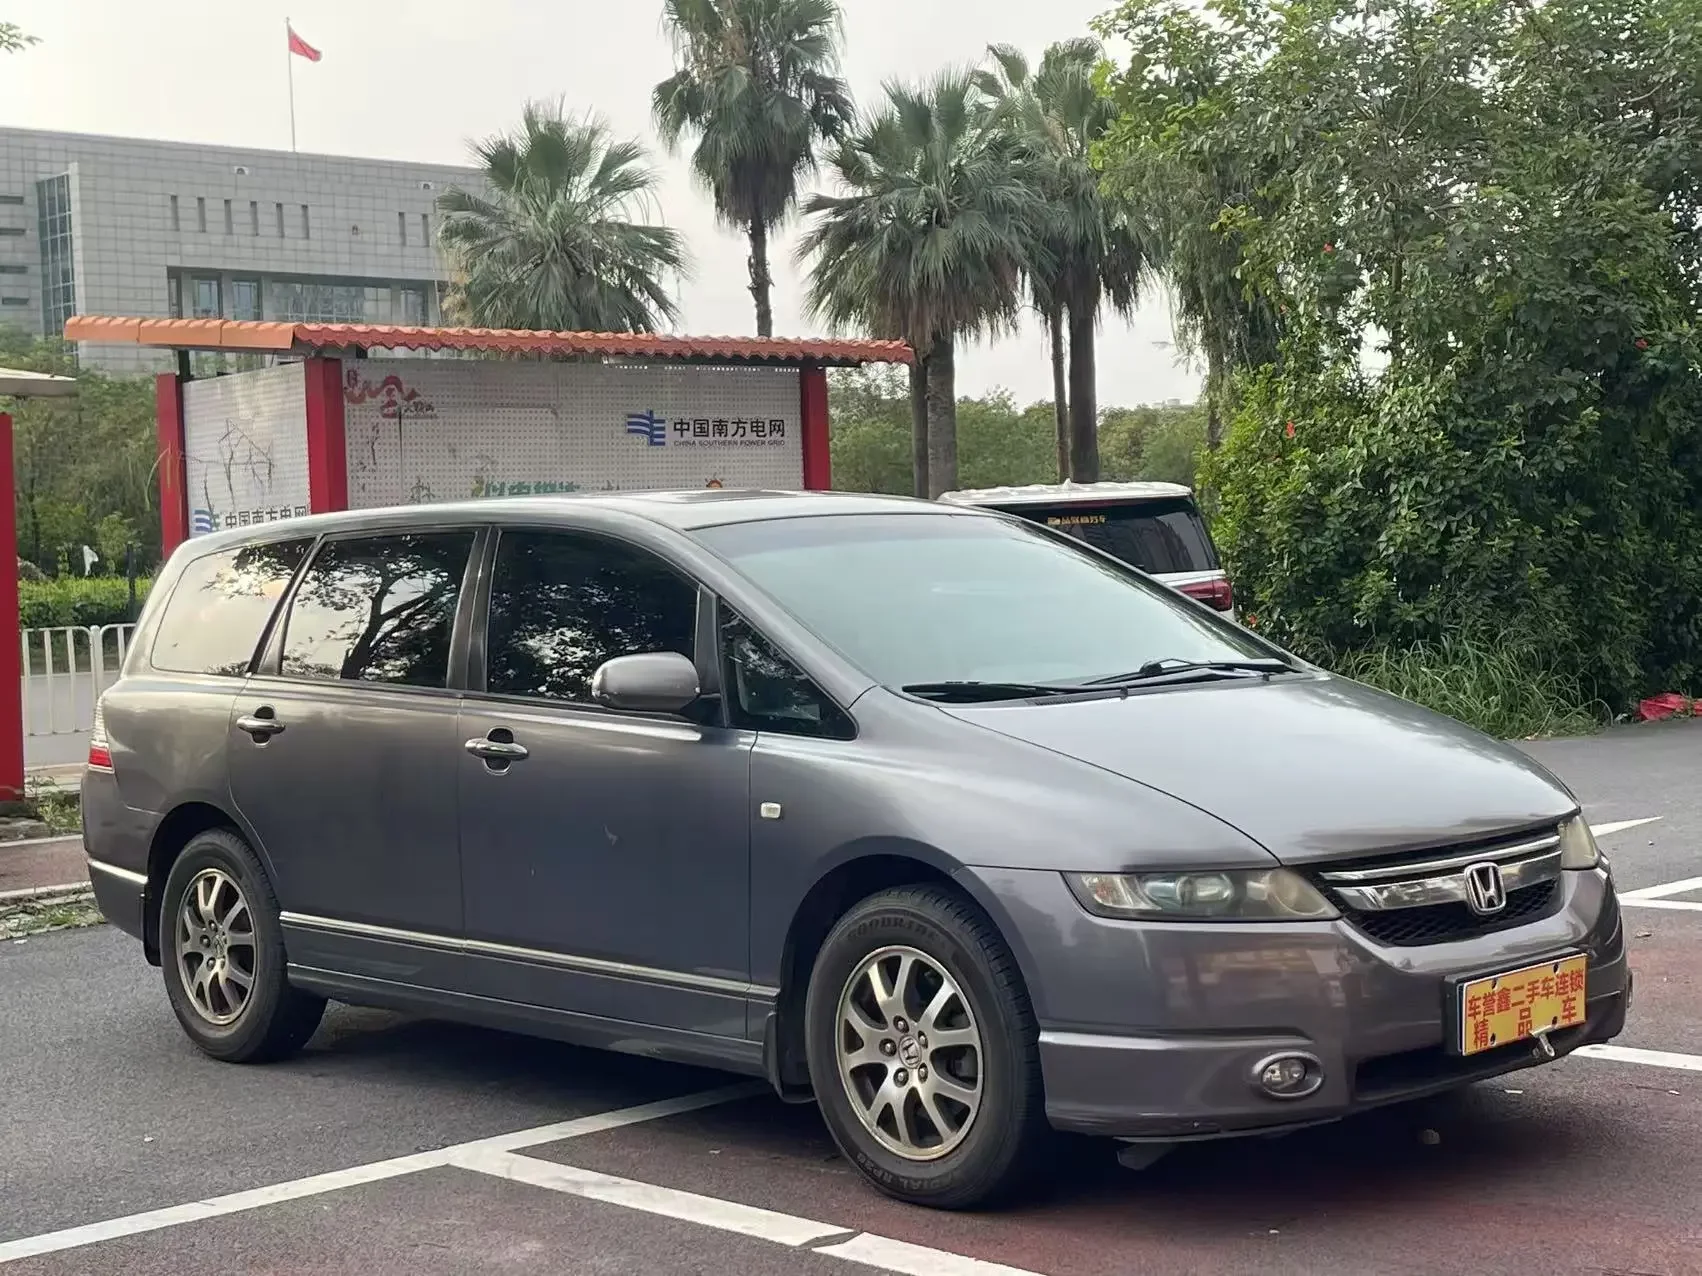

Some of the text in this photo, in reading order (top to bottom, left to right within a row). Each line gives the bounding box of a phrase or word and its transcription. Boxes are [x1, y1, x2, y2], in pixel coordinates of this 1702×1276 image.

[673, 418, 785, 438] 中国南方电网
[673, 439, 785, 447] CHINA SOUTHERN POWER GRID
